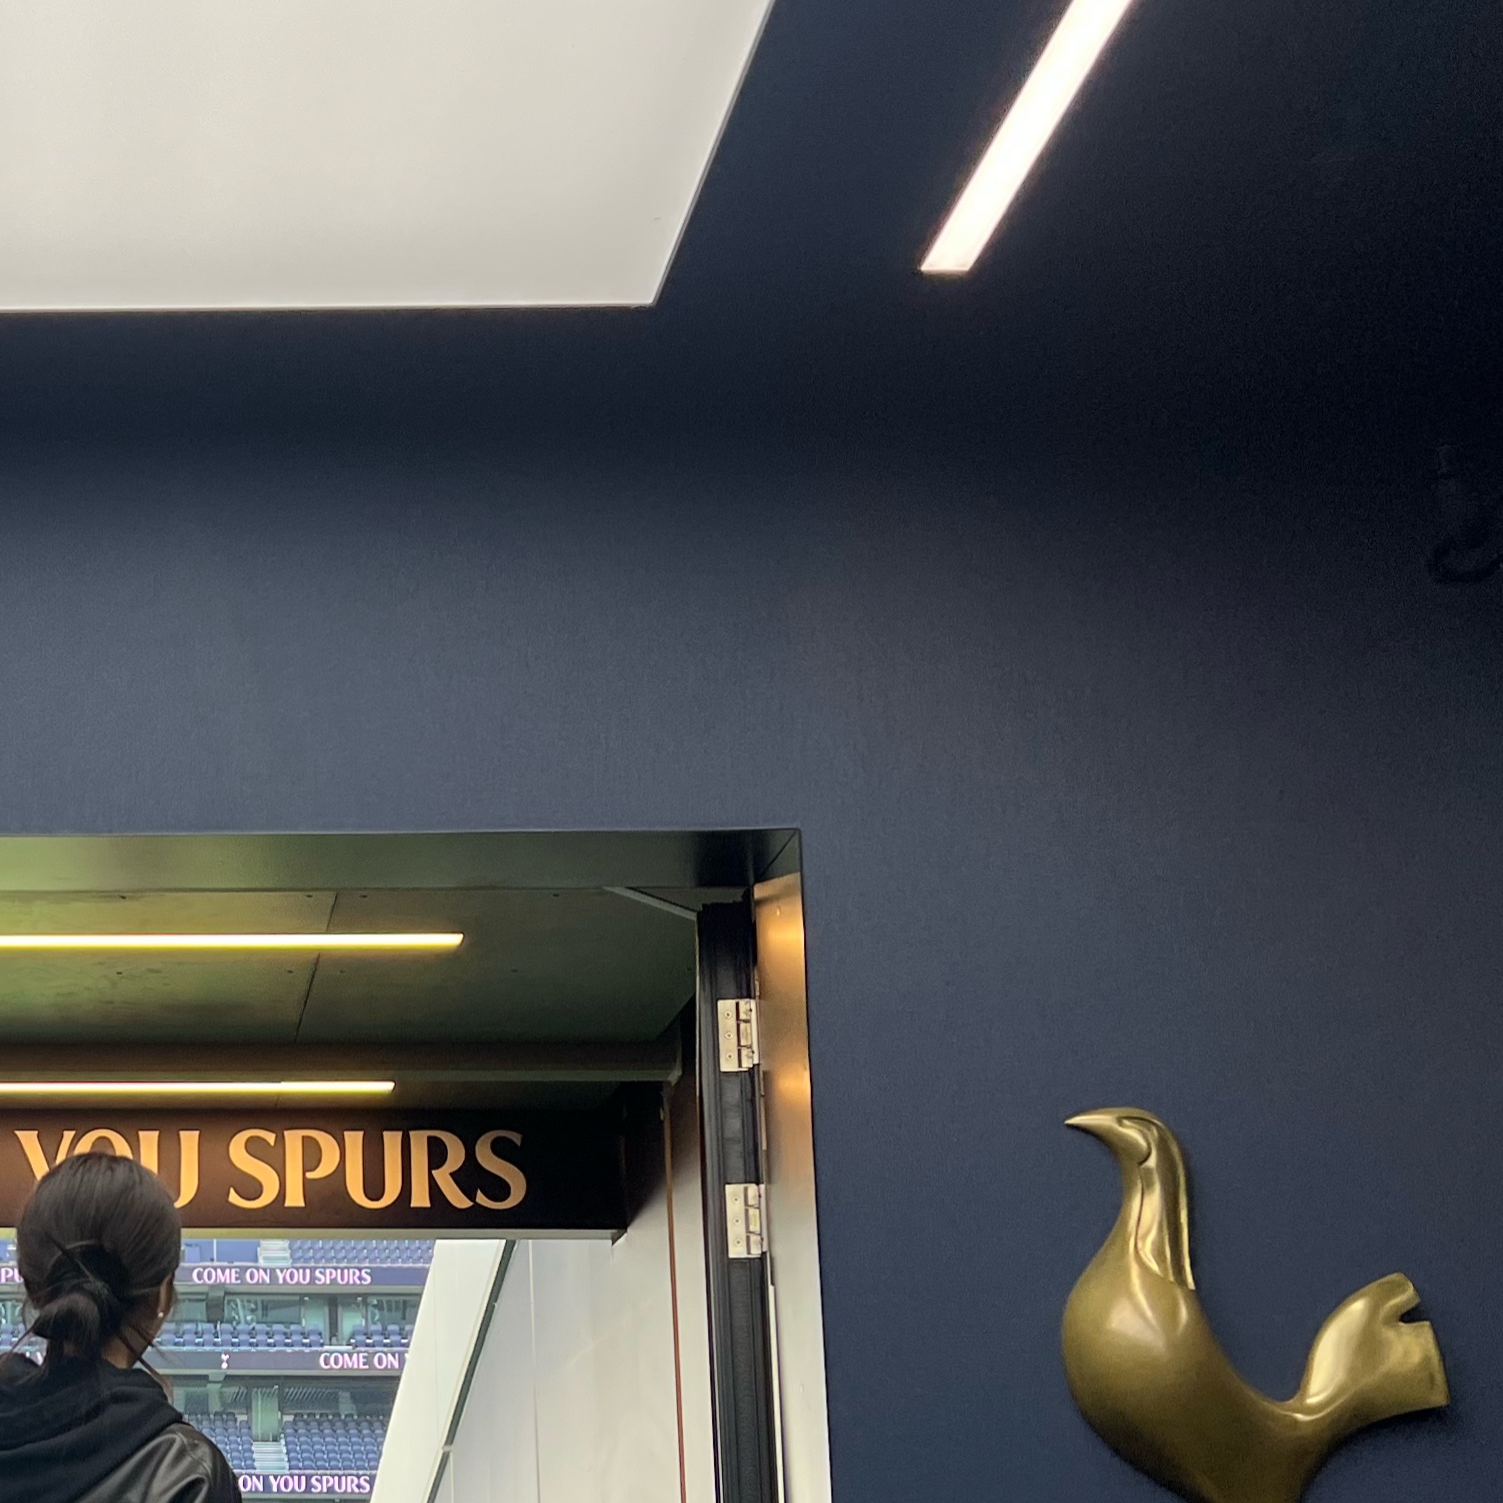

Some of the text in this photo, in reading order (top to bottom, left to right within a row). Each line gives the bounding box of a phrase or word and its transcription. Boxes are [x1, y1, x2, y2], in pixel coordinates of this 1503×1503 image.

[228, 1128, 527, 1209] SPURS
[192, 1267, 372, 1286] COME ON YOU SPURS
[319, 1352, 370, 1369] COME
[373, 1352, 399, 1369] ON
[238, 1475, 370, 1493] ON YOU SPURS
